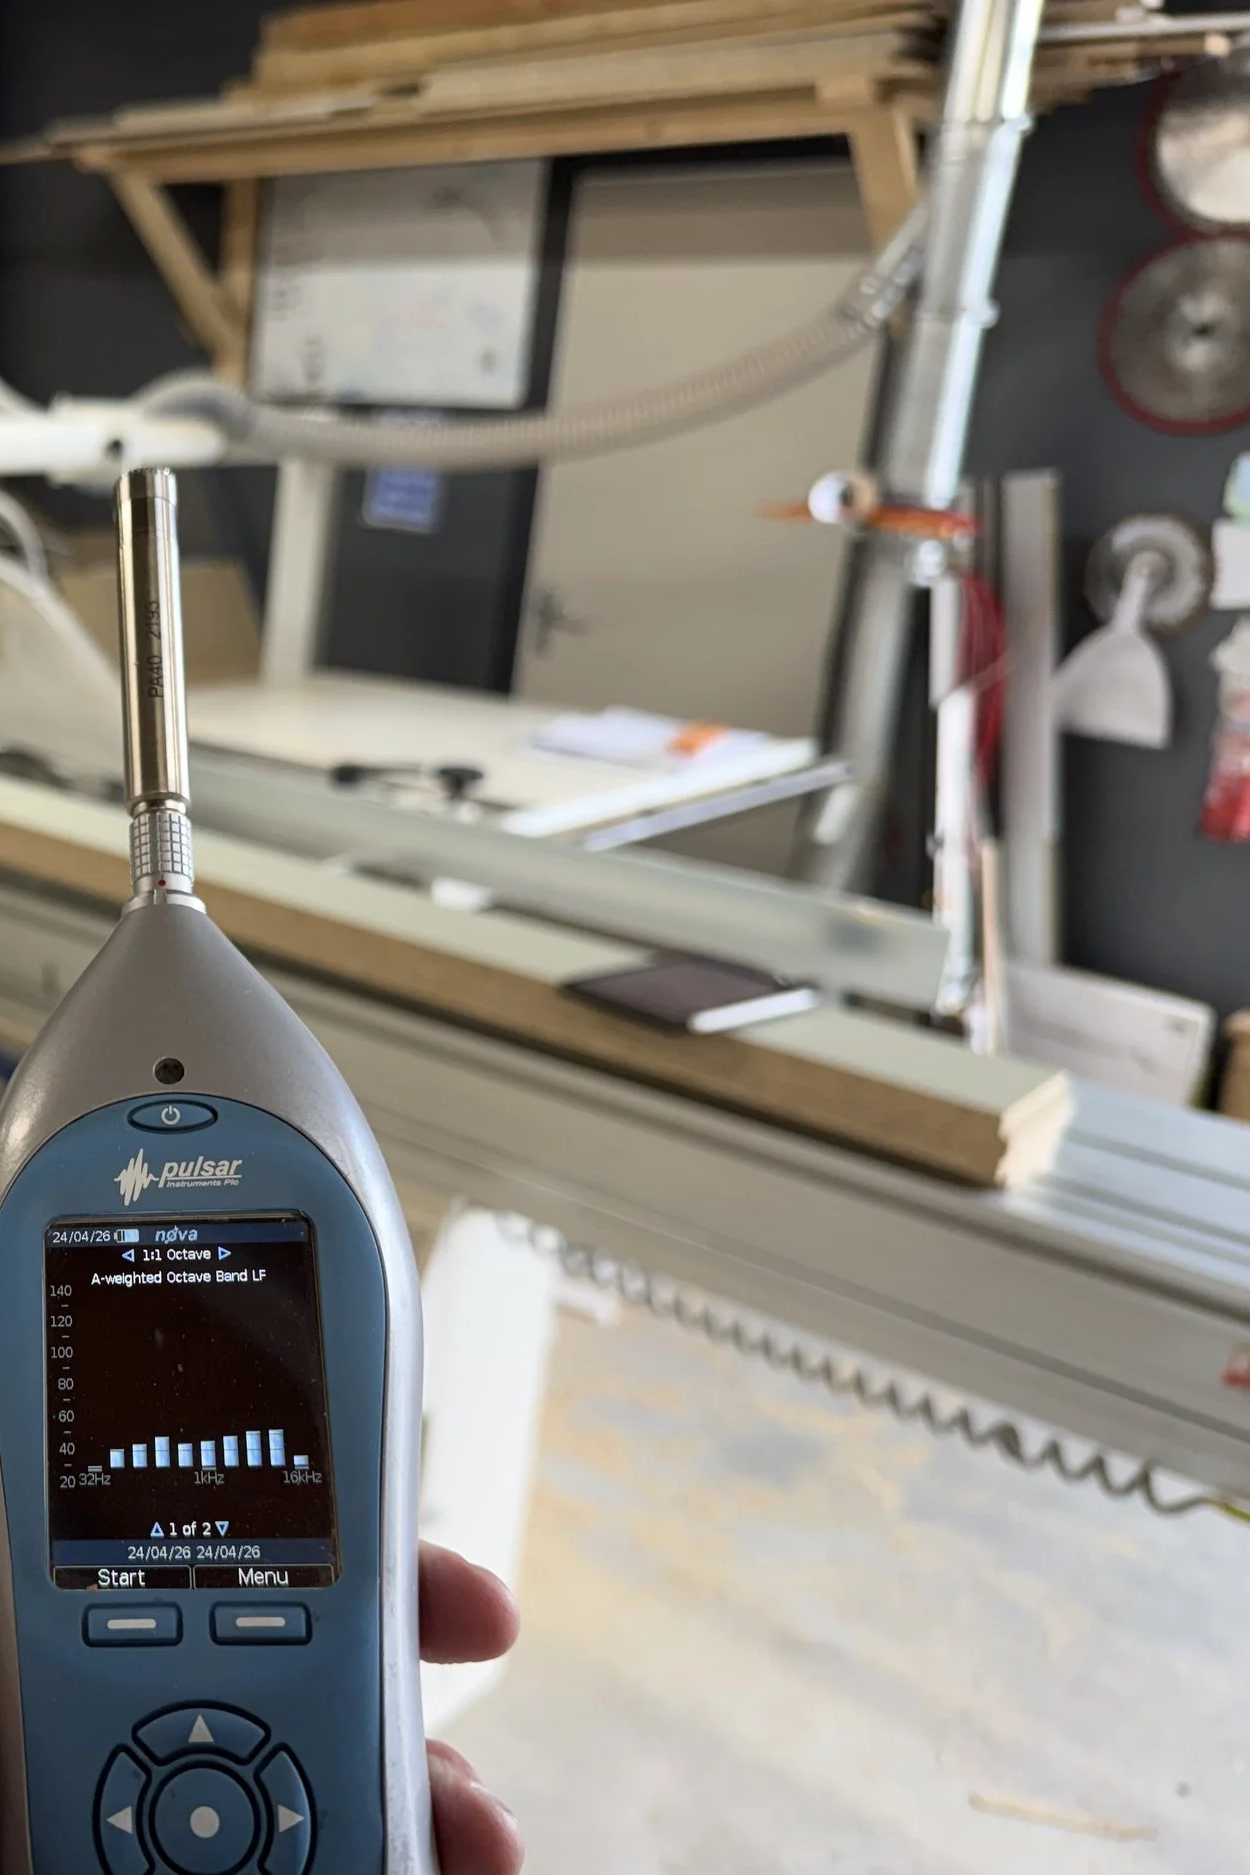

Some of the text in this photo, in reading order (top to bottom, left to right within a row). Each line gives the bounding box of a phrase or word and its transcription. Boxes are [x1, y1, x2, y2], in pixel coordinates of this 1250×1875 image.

[146, 655, 163, 698] PA40
[158, 1156, 242, 1188] pulsar
[166, 1180, 221, 1188] Instruments
[52, 1230, 111, 1244] 24/04/26
[143, 1249, 211, 1261] 1:1 Octave
[91, 1269, 266, 1288] A-weighted Octave Band LF
[50, 1285, 72, 1297] 140
[50, 1315, 73, 1327] 120
[51, 1346, 73, 1358] 100
[58, 1378, 74, 1390] 80
[58, 1410, 75, 1422] 60
[59, 1442, 75, 1455] 40
[60, 1475, 76, 1489] 20
[79, 1473, 111, 1485] 32Hz
[194, 1471, 225, 1485] 1kHz
[283, 1470, 322, 1484] 16kHz
[169, 1521, 211, 1535] 1 of 2
[127, 1545, 261, 1560] 24/04/26 24/04/26
[98, 1569, 145, 1586] Start
[238, 1568, 289, 1585] Menu
